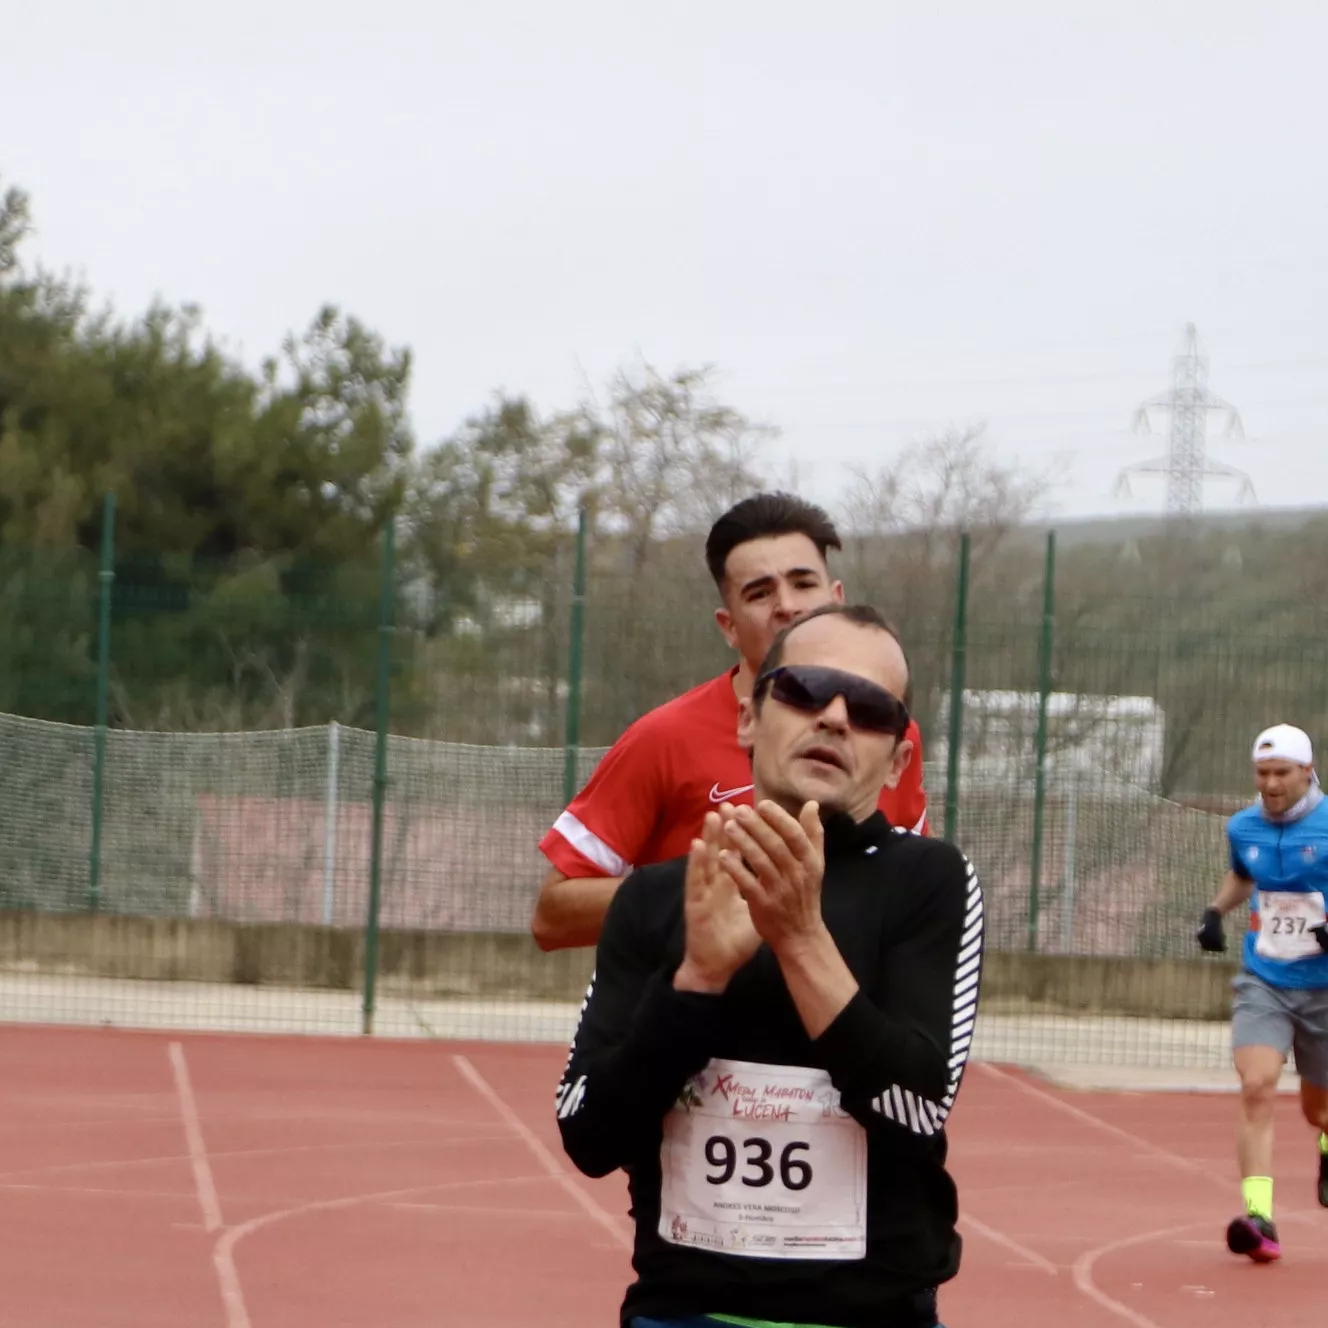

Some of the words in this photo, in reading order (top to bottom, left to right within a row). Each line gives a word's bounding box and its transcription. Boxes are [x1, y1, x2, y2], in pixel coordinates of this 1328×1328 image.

[1272, 917, 1307, 935] 237
[733, 1098, 798, 1122] LUCENA
[704, 1135, 813, 1191] 936
